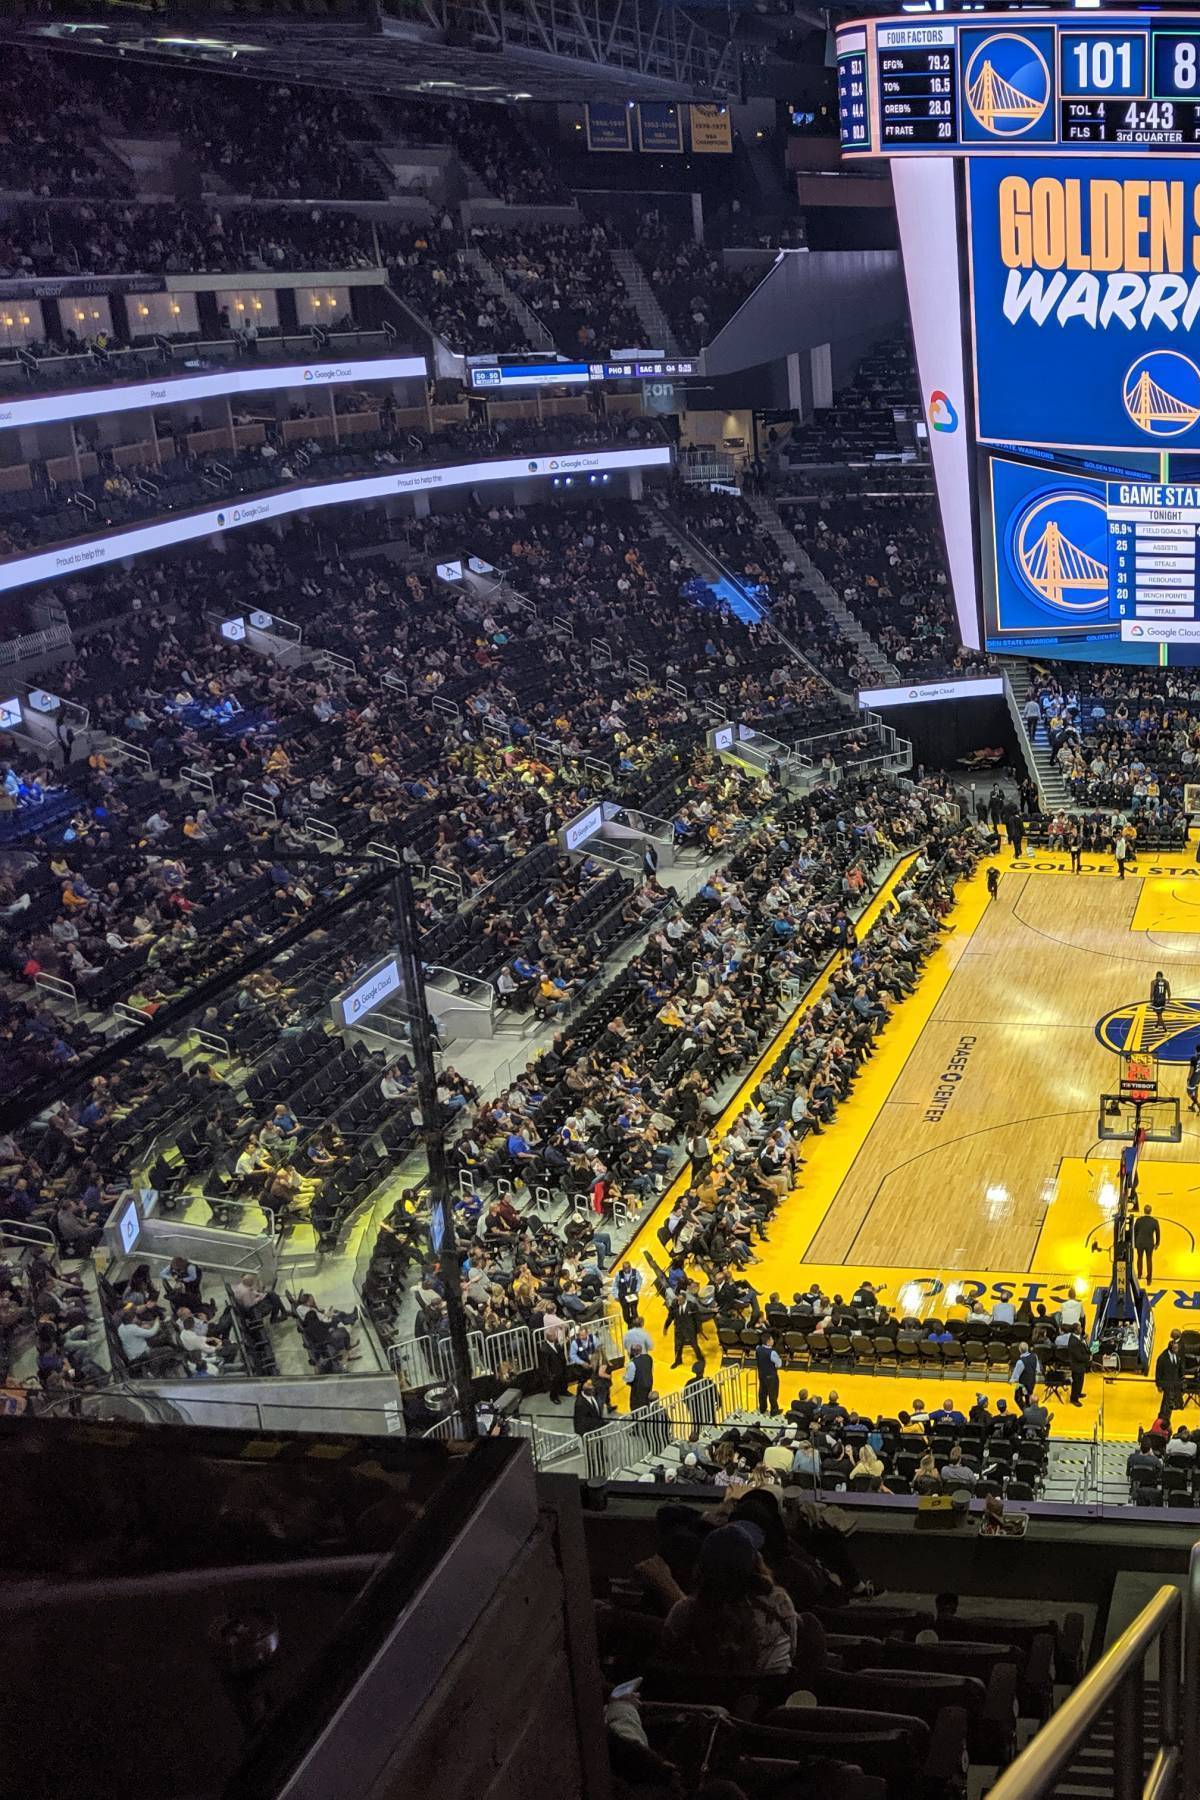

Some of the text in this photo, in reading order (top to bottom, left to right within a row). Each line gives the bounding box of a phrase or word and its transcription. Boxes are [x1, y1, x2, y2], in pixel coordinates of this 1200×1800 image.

[887, 30, 943, 44] FOUR FACTORS
[883, 55, 950, 70] EFG% 79.2
[1074, 42, 1131, 88] 101
[884, 78, 950, 92] TO% 16.5
[885, 100, 951, 115] OREB% 28.0
[1069, 103, 1105, 117] TOL 4
[1125, 102, 1174, 129] 4:43
[885, 122, 951, 137] FT RATE 20
[1070, 125, 1105, 140] FLS 1
[1116, 132, 1182, 142] 3rd QUARTER
[999, 175, 1184, 273] GOLDEN
[314, 369, 335, 380] Google
[561, 458, 599, 470] Google Cloud
[397, 478, 414, 487] Proud
[421, 476, 432, 486] help
[1120, 485, 1162, 504] GAME
[1149, 510, 1182, 520] TONIGHT
[56, 555, 74, 568] Proud
[1118, 573, 1127, 583] 31
[1147, 628, 1176, 638] Google
[920, 689, 939, 698] Google
[1159, 986, 1164, 994] 11
[922, 1036, 976, 1122] CHASE CENTER
